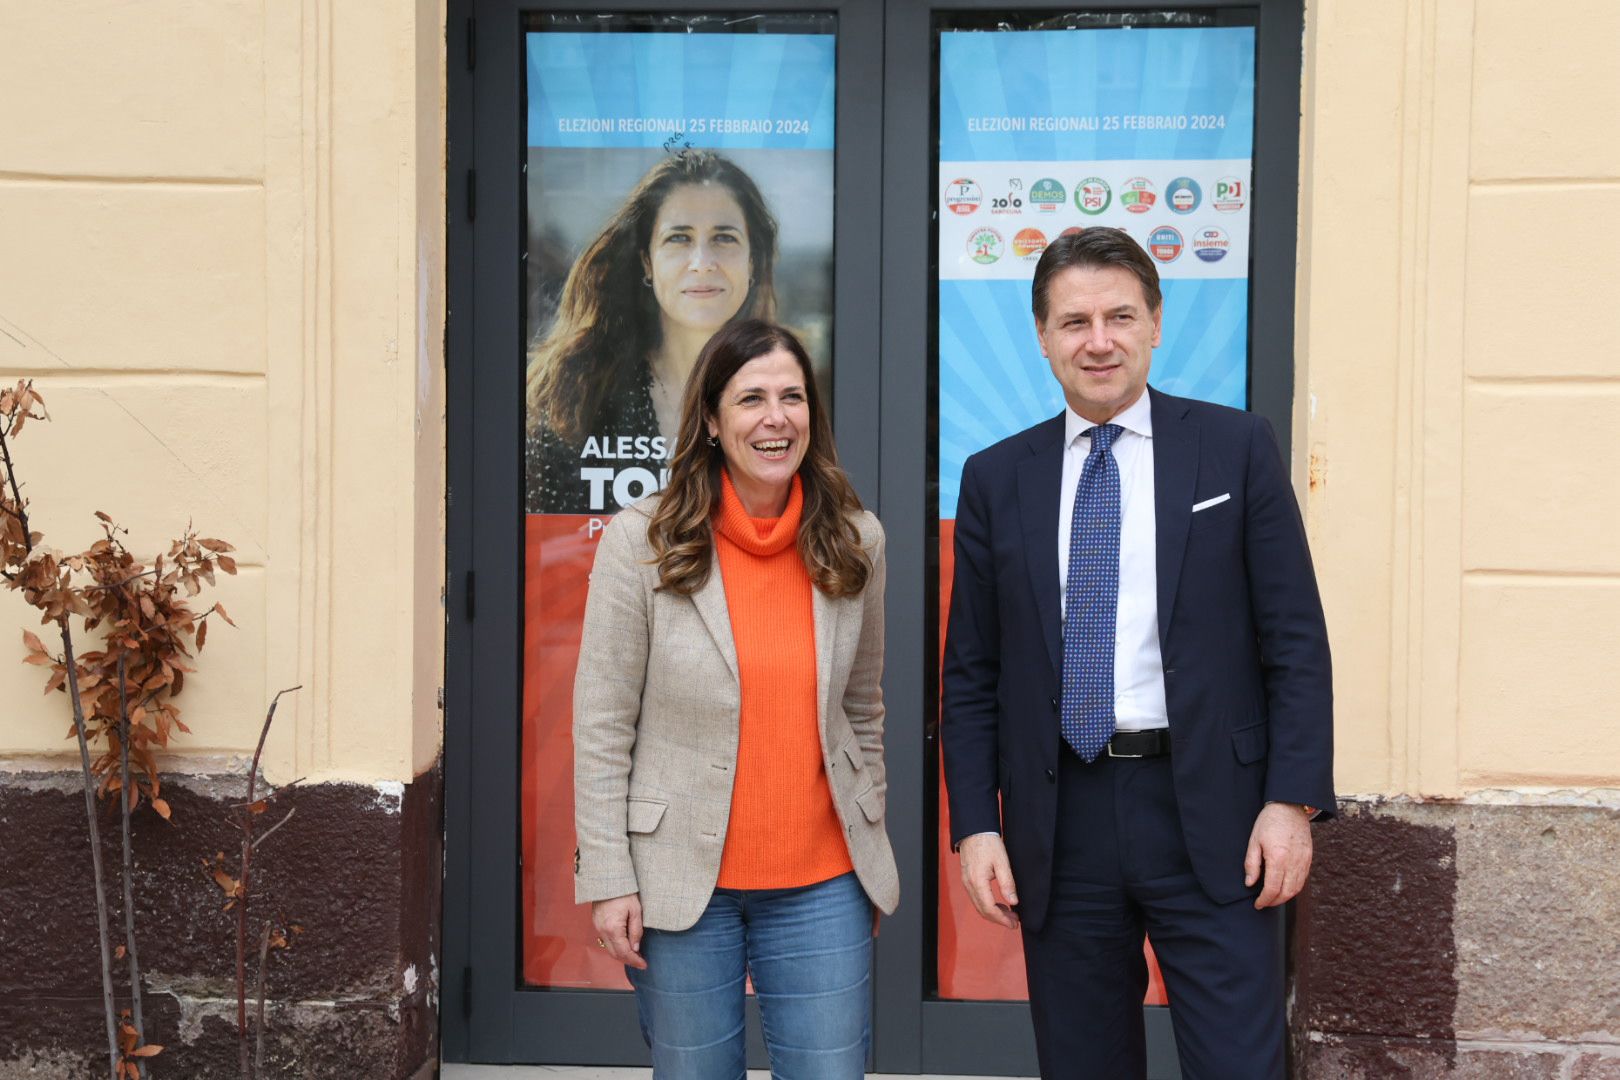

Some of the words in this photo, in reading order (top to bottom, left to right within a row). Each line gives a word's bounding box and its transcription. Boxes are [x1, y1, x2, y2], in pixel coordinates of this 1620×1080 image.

[558, 118, 615, 132] ELEZIONI
[618, 118, 686, 133] REGIONALI
[690, 118, 706, 133] 25
[710, 119, 772, 134] FEBBRAIO
[776, 120, 809, 134] 2024
[967, 117, 1026, 132] ELEZIONI
[1030, 117, 1099, 131] REGIONALI
[1103, 116, 1120, 131] 25
[1123, 115, 1187, 130] FEBBRAIO
[1191, 115, 1226, 129] 2024
[1031, 191, 1064, 199] DEMOS
[1216, 182, 1241, 198] PD
[1084, 197, 1102, 207] PSI
[1193, 240, 1230, 248] insieme
